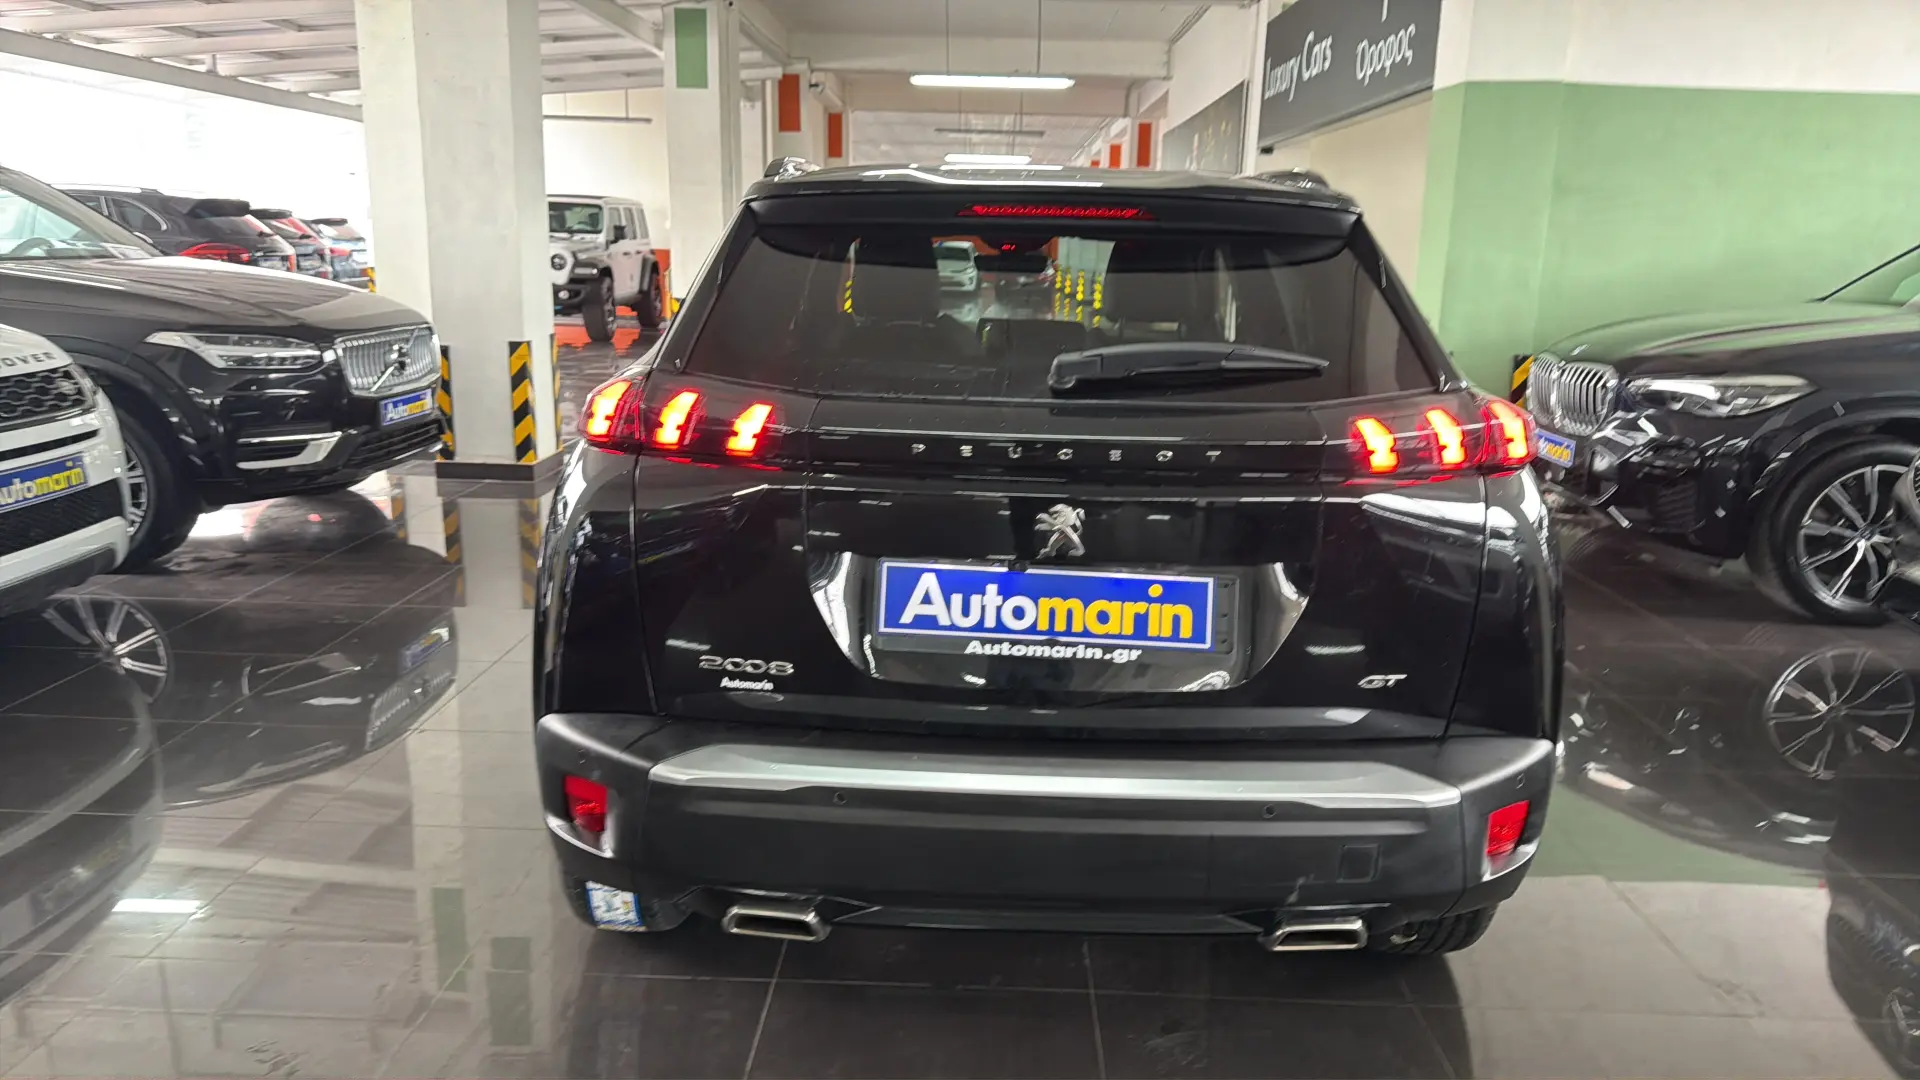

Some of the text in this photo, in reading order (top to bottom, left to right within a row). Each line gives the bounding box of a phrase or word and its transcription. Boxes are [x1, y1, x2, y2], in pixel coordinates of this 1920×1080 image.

[1264, 30, 1332, 102] Luxury Cars
[0, 351, 57, 369] OVER
[911, 443, 1221, 463] PEUGEOT
[899, 571, 1193, 639] Automarin
[964, 639, 1142, 664] Automarin.gr
[698, 654, 795, 676] 2008
[1357, 673, 1408, 689] GT
